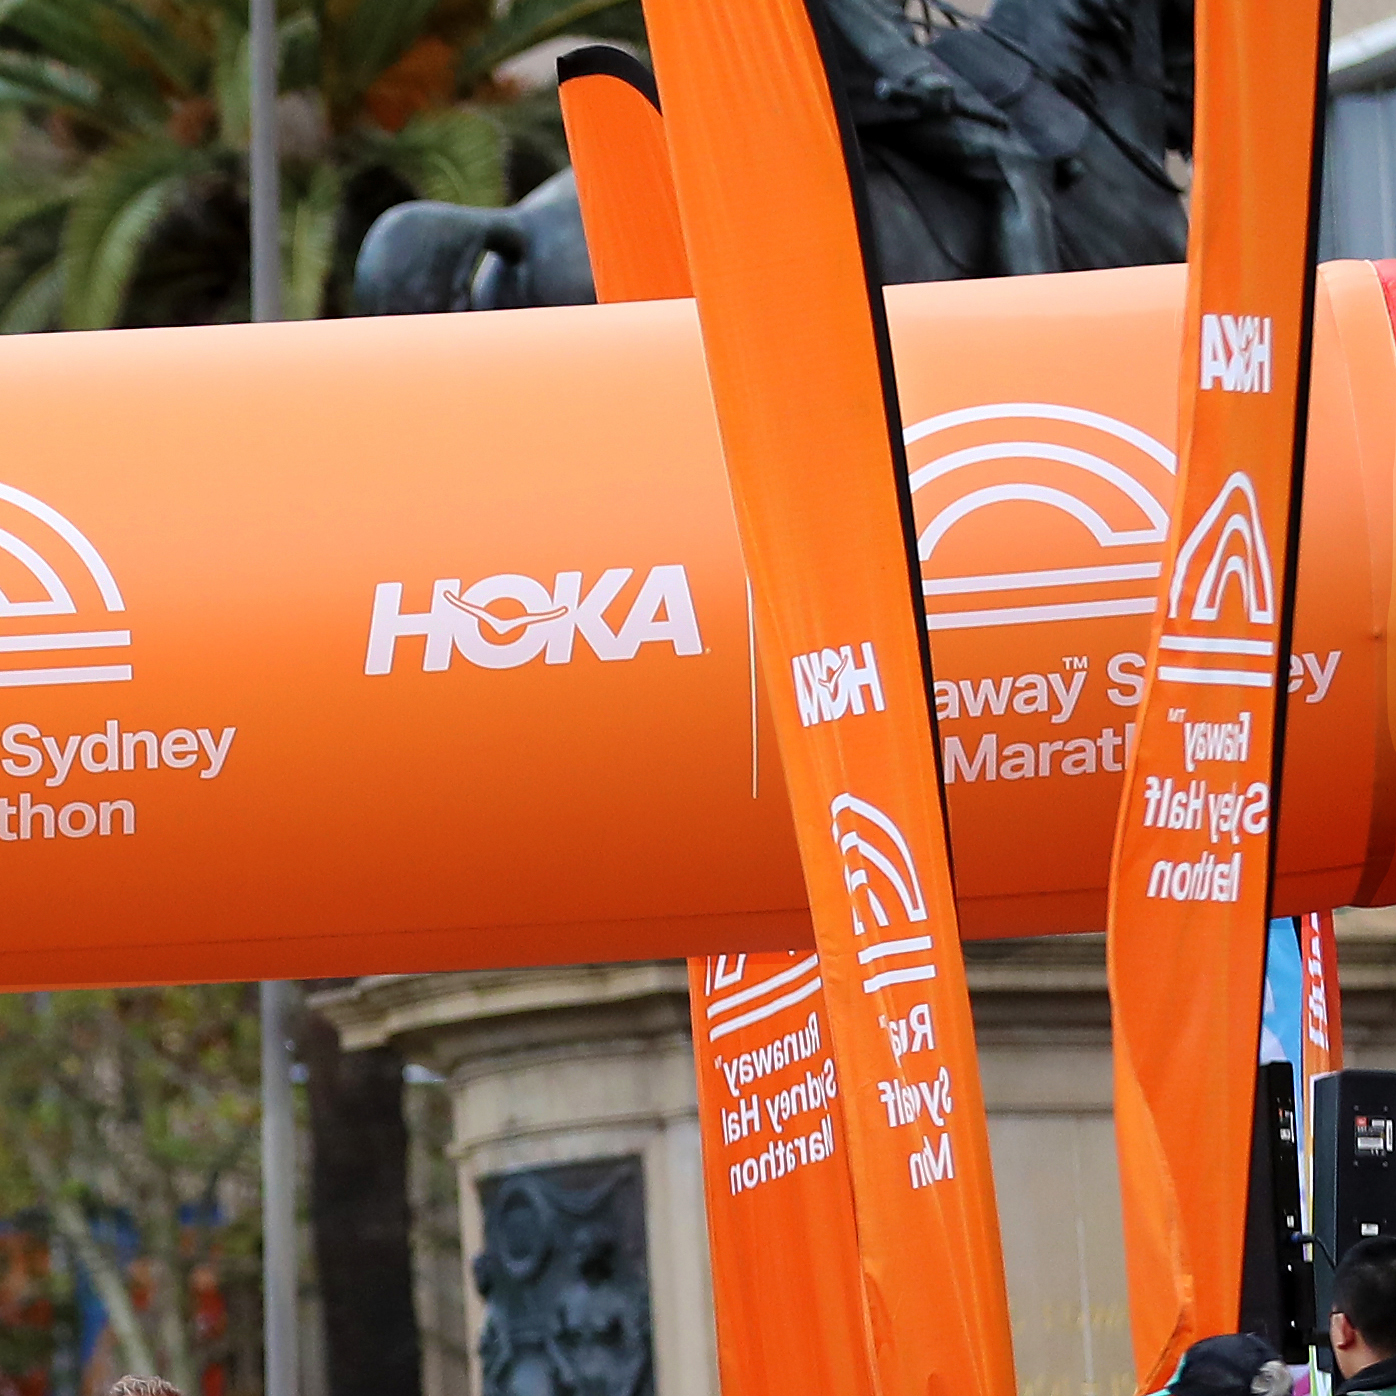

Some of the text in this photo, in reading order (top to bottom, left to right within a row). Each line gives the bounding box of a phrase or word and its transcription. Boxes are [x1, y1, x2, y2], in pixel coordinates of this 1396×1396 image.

[364, 564, 703, 676] HOKA
[1, 719, 237, 787] Sydney
[944, 724, 1136, 784] Marat
